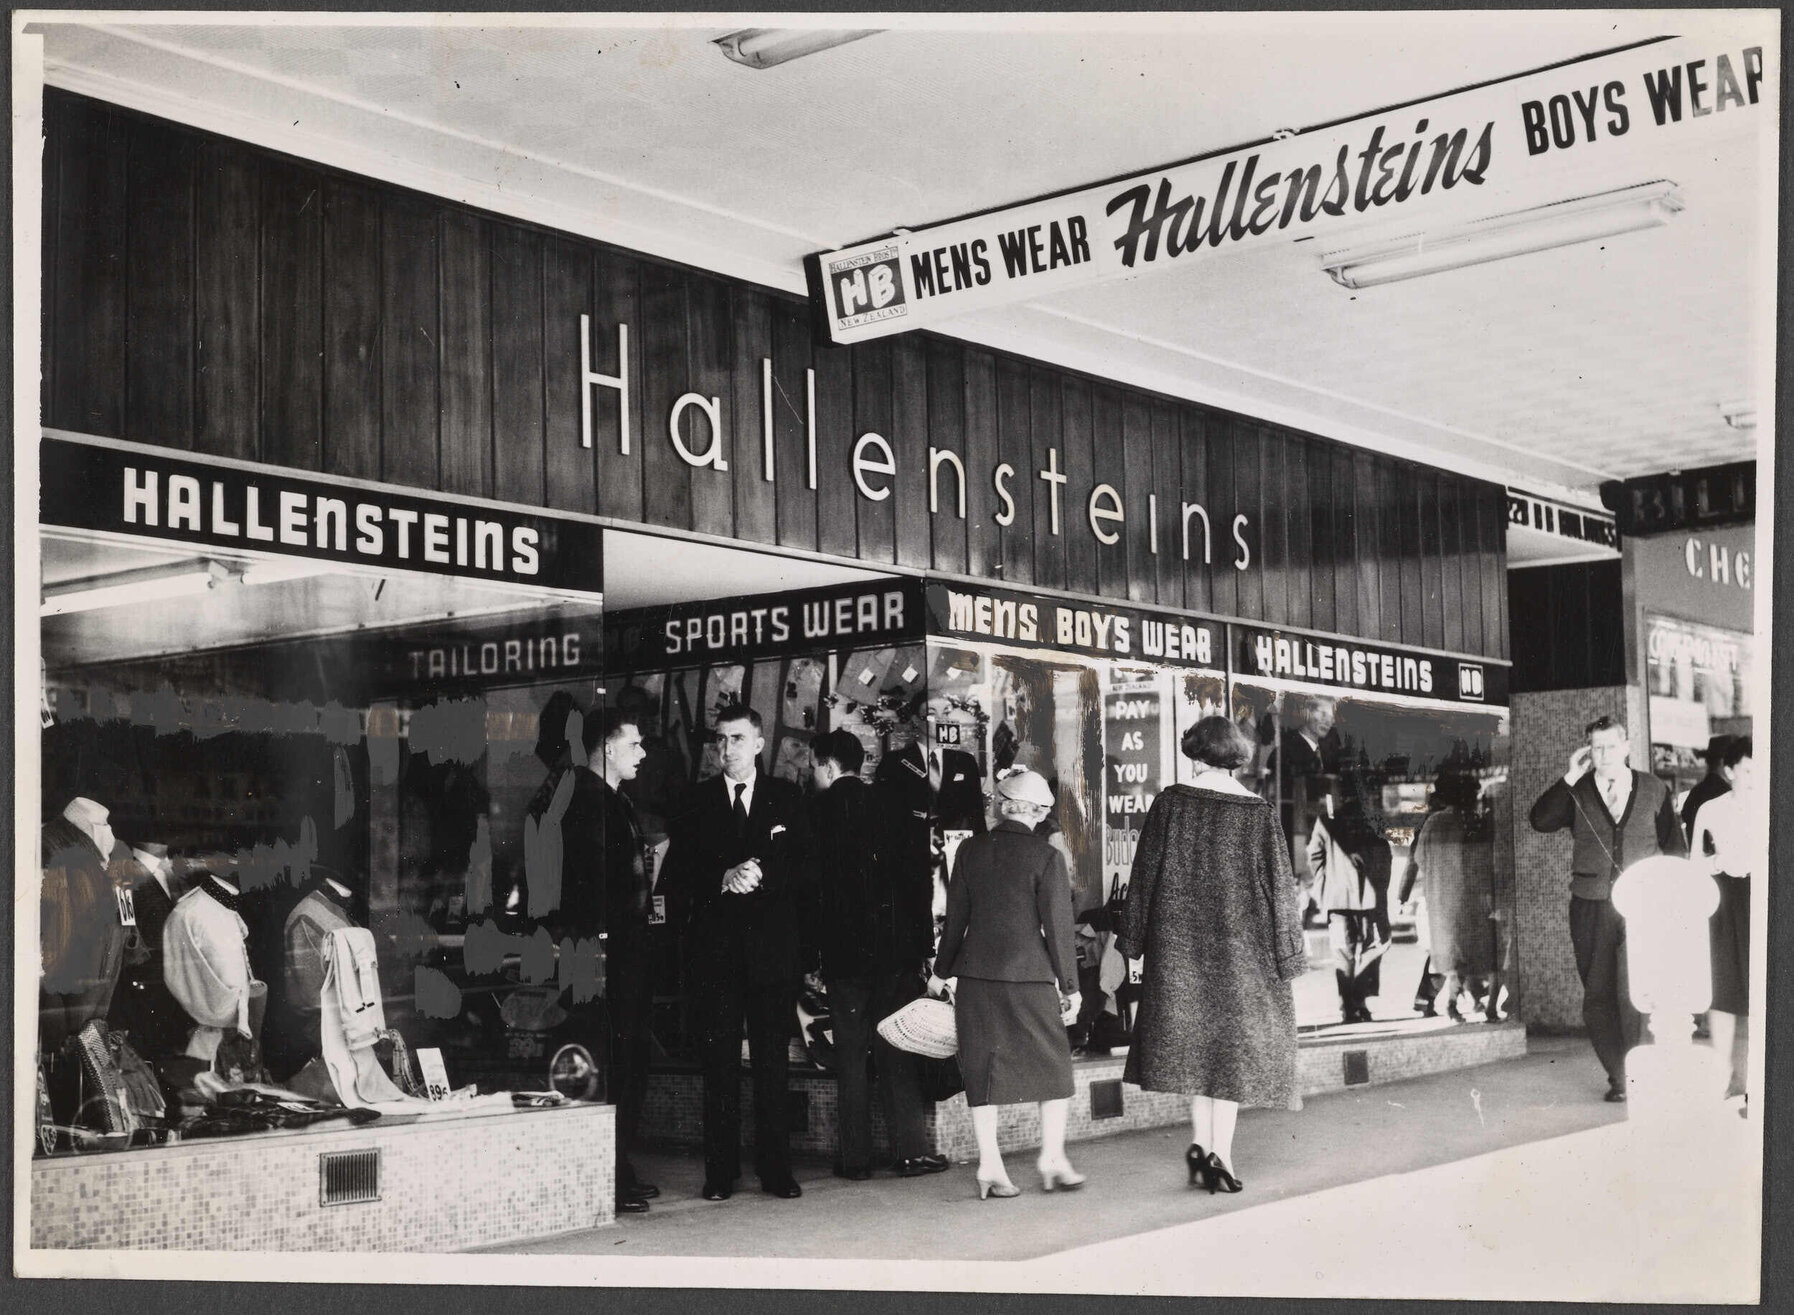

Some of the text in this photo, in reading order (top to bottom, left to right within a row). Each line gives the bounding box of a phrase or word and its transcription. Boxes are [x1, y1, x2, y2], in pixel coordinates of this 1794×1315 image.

[910, 238, 992, 300] MENS
[997, 215, 1091, 279] WEAR
[1106, 118, 1496, 268] Hallensteins
[1521, 80, 1630, 156] BOYS
[840, 264, 896, 317] HB
[840, 306, 906, 328] NEW ZEALAND
[580, 314, 1250, 570] Hallensteins
[123, 467, 539, 576] HALLENSTEINS
[666, 607, 790, 655] SPORTS
[803, 592, 904, 639] WEAR
[949, 590, 1212, 664] MENS BOYS WEAR
[407, 633, 580, 679] TAILORING
[1256, 635, 1433, 693] HALLENSTEINS
[1115, 700, 1149, 720] PAY
[1121, 732, 1144, 751] AS
[1114, 763, 1148, 783] YOU
